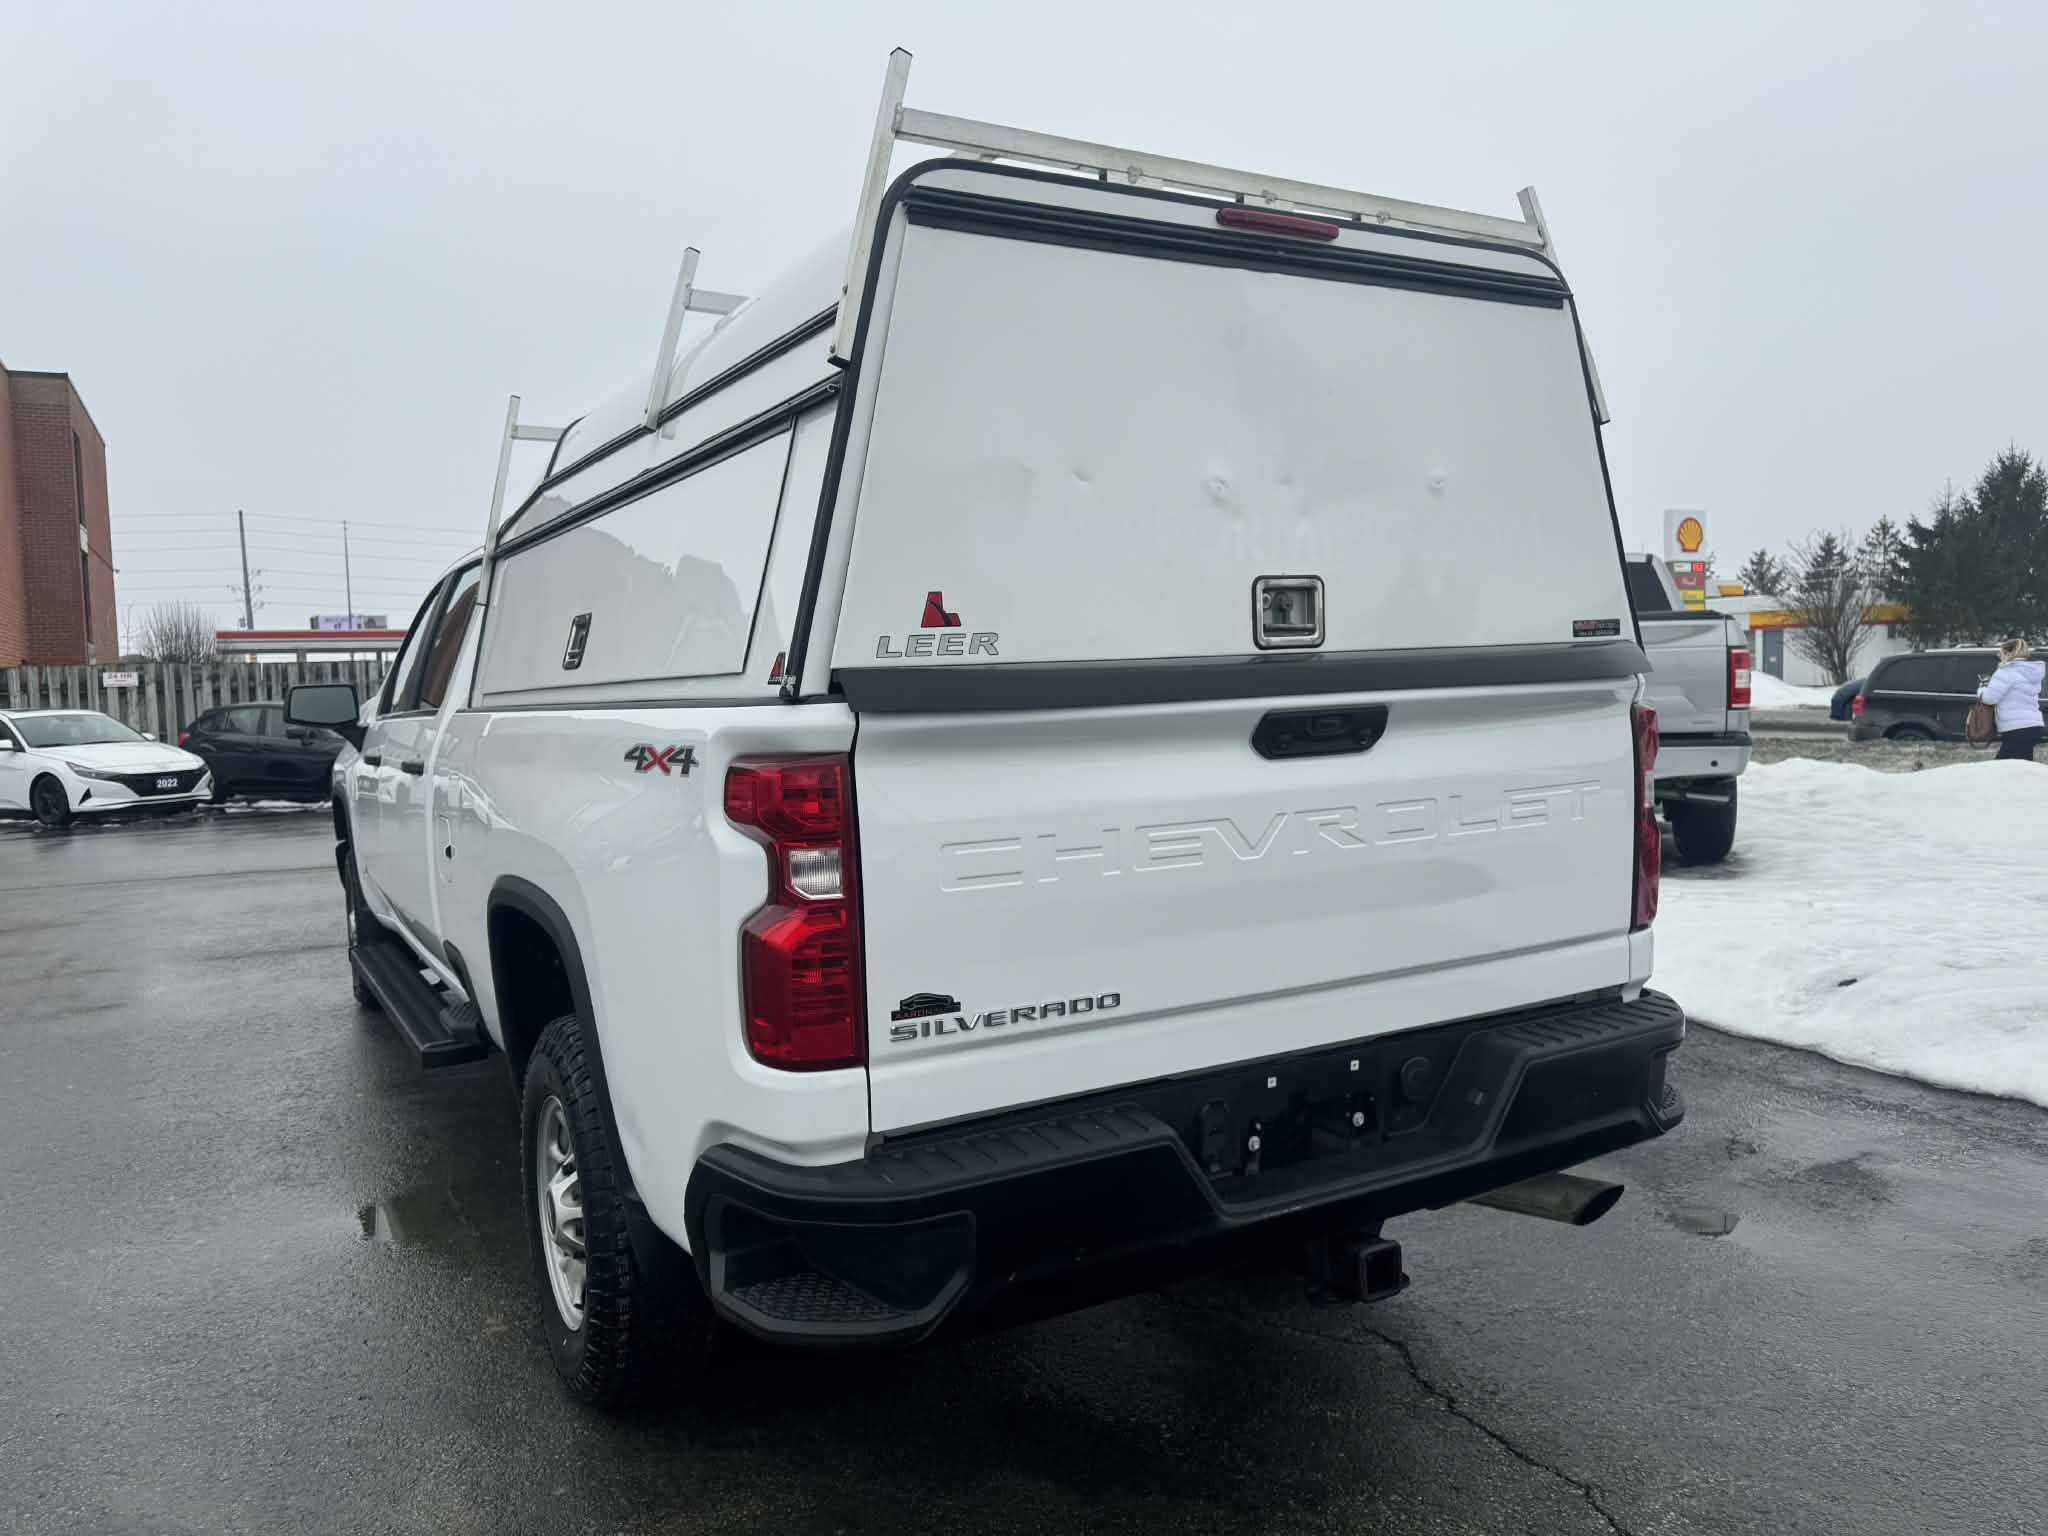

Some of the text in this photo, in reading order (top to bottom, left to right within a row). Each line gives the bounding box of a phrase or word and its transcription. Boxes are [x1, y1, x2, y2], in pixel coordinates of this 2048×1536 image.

[875, 632, 999, 659] LEER
[940, 779, 1601, 892] CHEVROLET
[890, 991, 1121, 1042] SILVERADO
